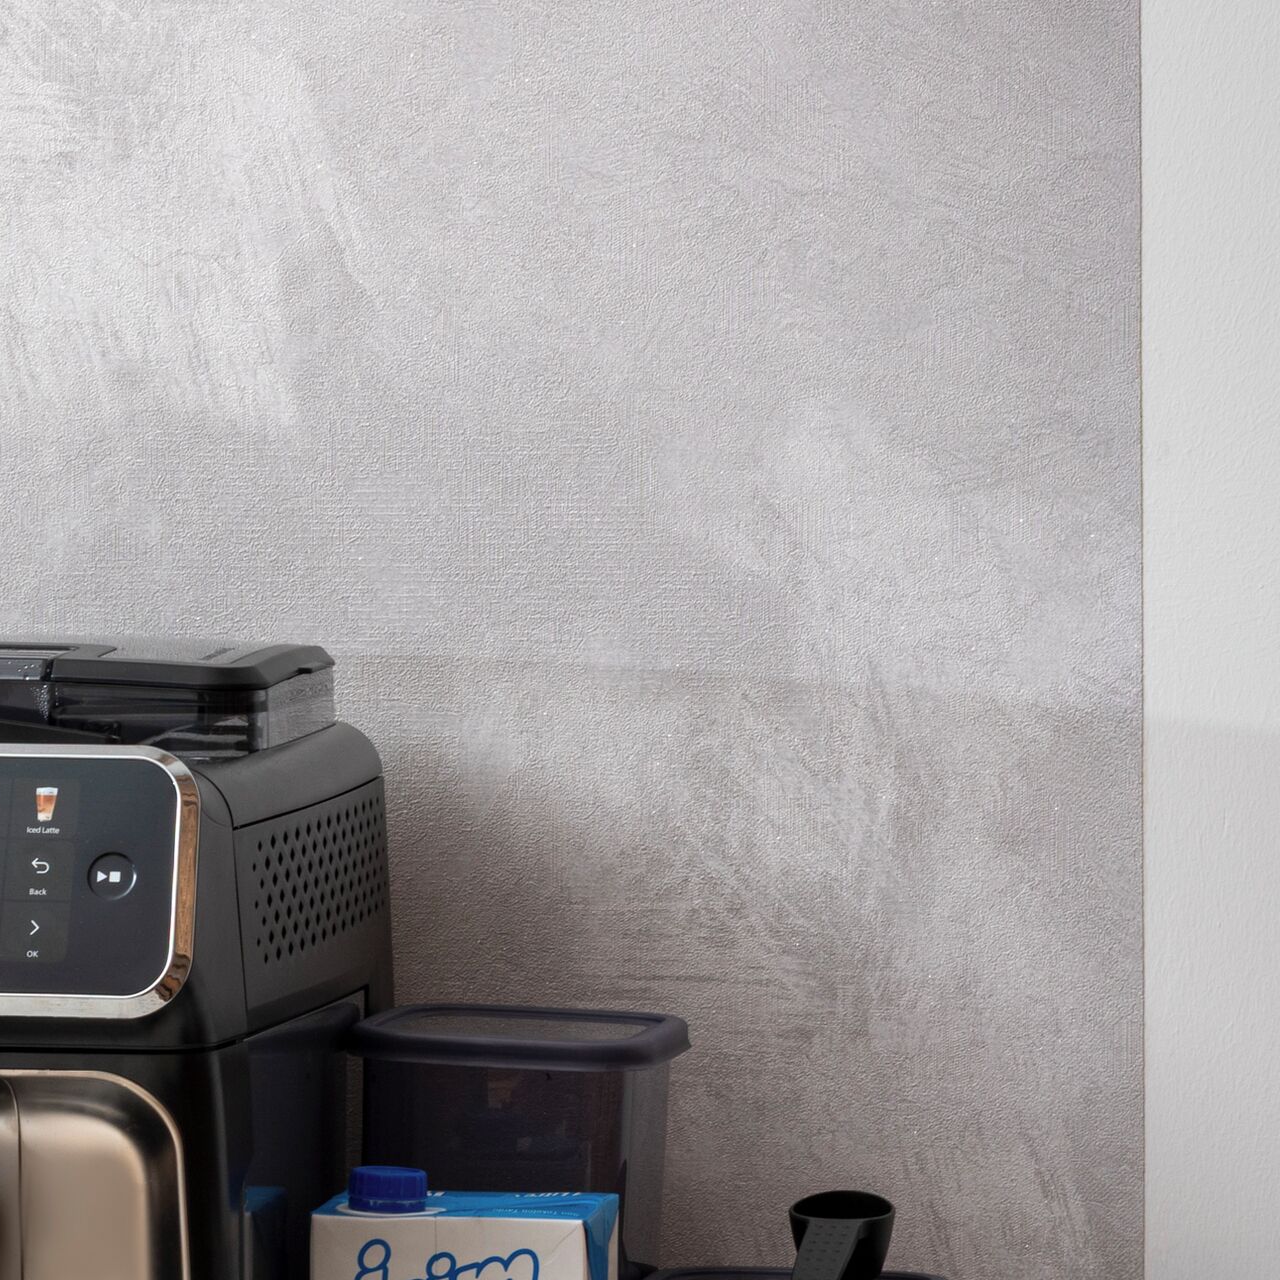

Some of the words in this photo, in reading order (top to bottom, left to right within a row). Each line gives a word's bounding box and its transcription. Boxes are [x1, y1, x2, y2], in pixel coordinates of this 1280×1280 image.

[26, 826, 40, 834] Iced
[41, 826, 60, 835] Latte
[28, 887, 47, 896] Back
[26, 950, 39, 958] OK
